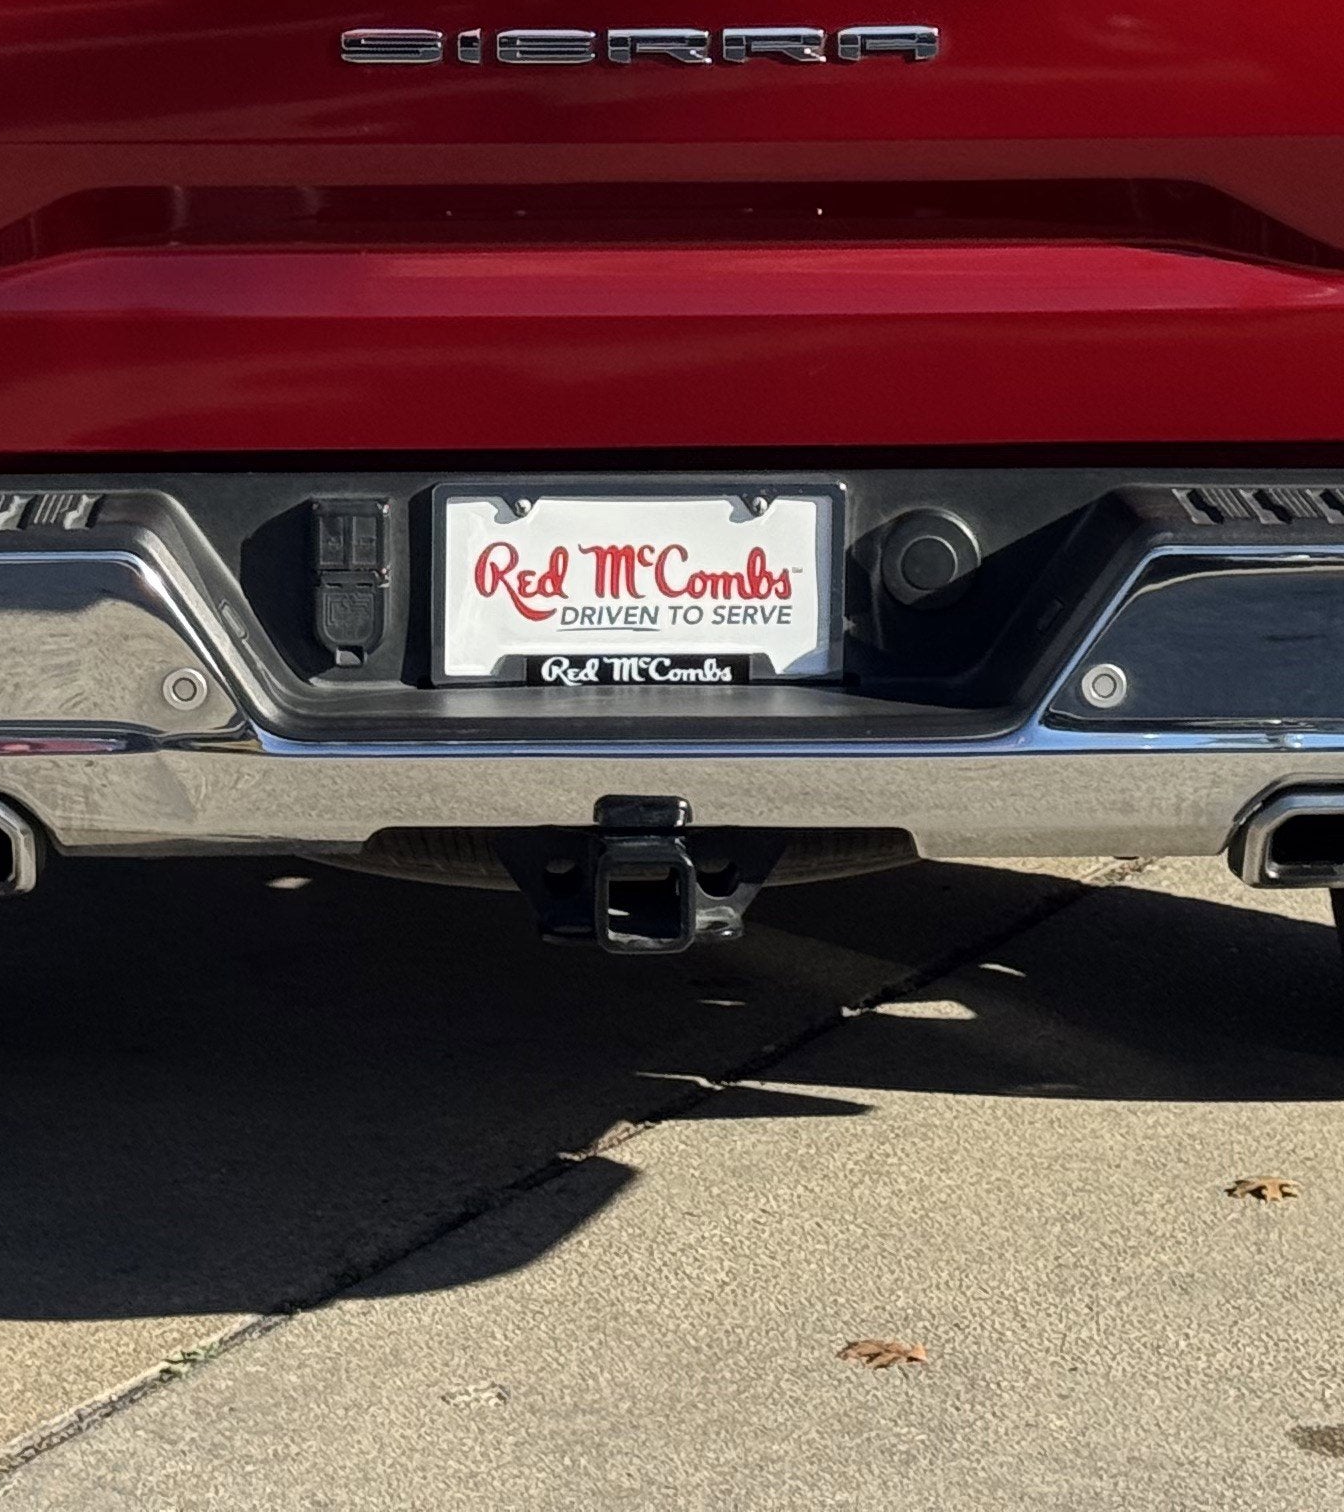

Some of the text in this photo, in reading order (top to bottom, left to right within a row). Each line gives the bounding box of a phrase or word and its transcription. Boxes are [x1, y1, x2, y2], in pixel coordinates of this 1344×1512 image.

[340, 26, 940, 65] SIERRA
[474, 541, 793, 622] Red McCombs
[560, 604, 793, 626] DRIVEN TO SERVE
[541, 656, 732, 686] Red McCombs
